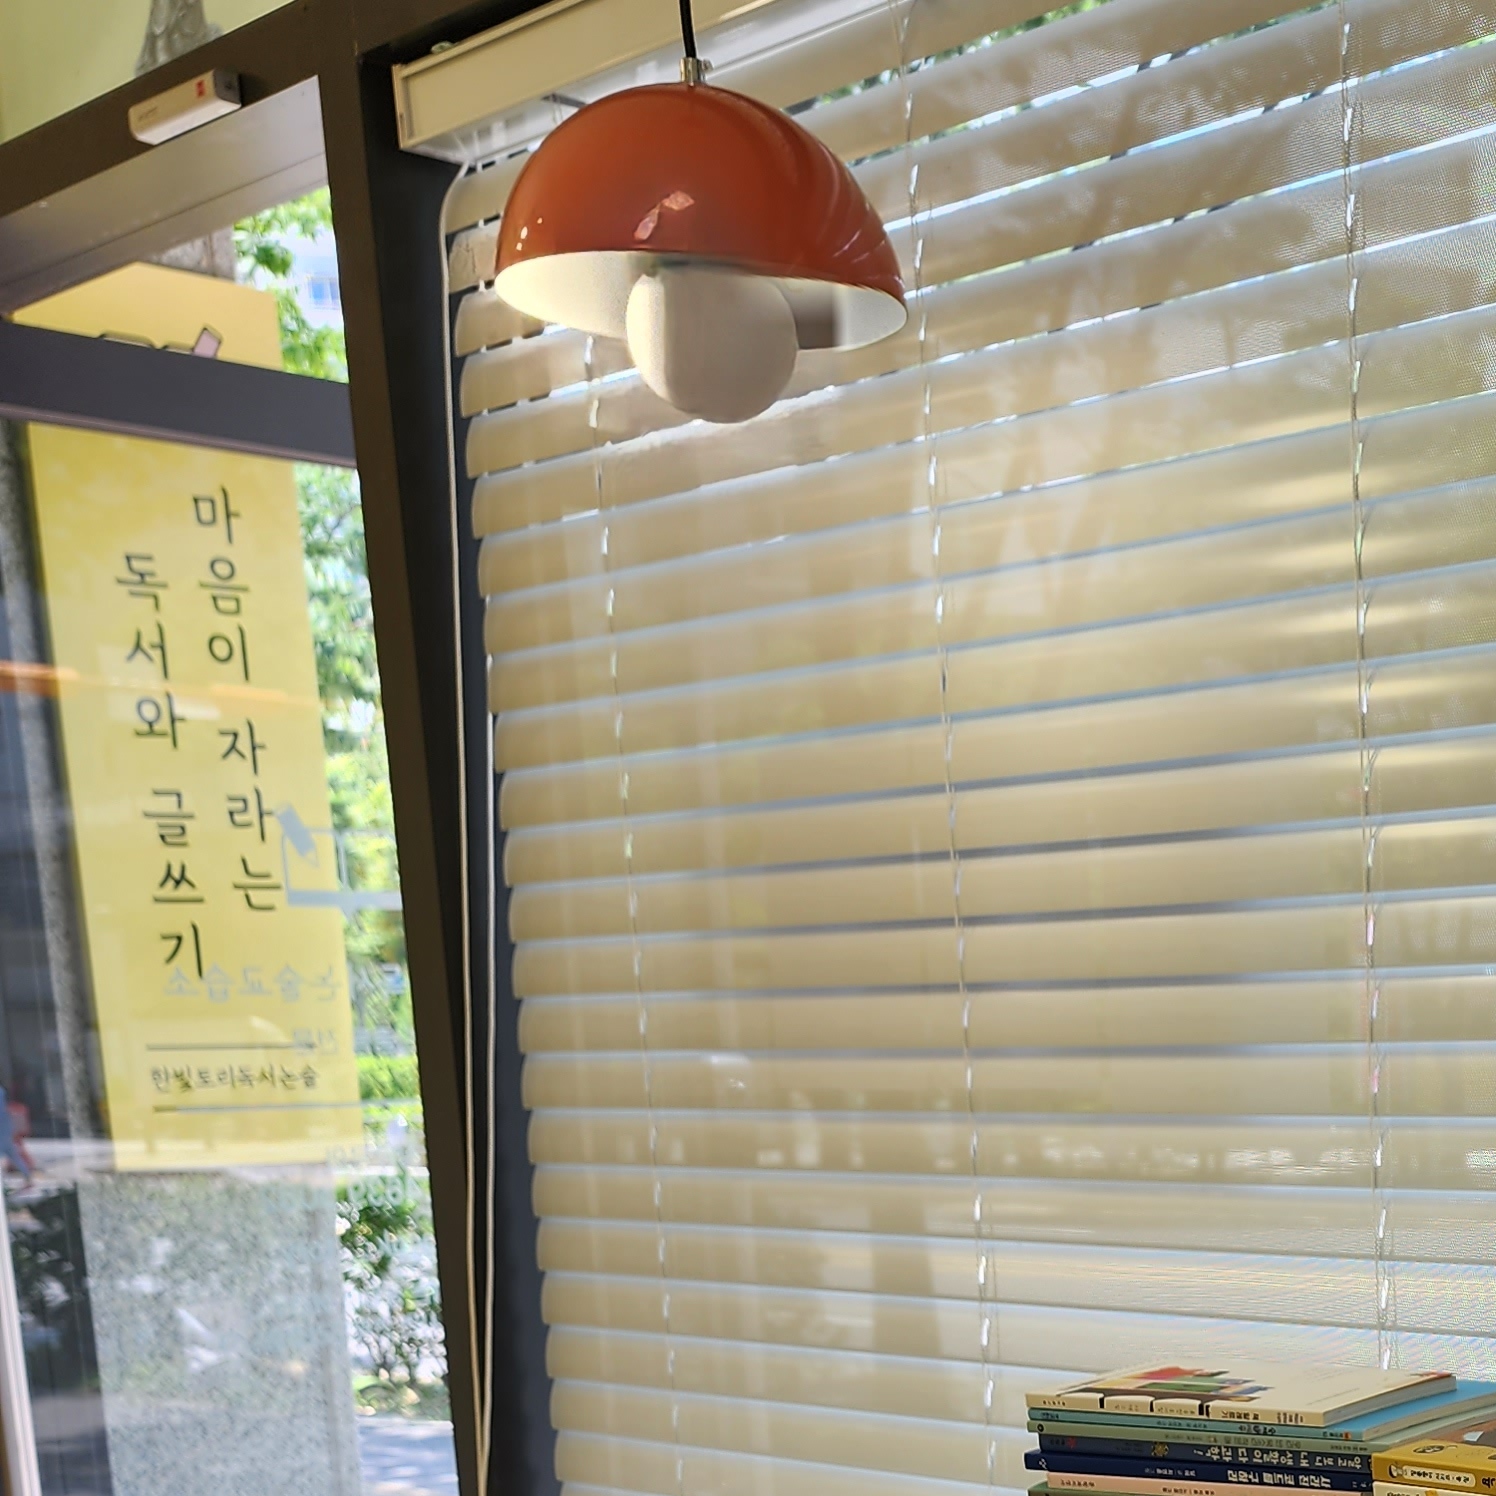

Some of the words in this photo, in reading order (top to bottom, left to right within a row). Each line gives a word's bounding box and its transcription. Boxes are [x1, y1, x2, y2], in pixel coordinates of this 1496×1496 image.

[192, 486, 250, 682] 마음이
[115, 553, 187, 750] 독서와
[220, 721, 282, 911] 자라는
[142, 788, 205, 978] 글쓰기
[151, 1063, 319, 1092] 한빛토리독서논술
[1195, 1444, 1230, 1462] 과학!
[1237, 1448, 1247, 1461] 다
[1254, 1450, 1292, 1466] 생활이
[1299, 1454, 1309, 1467] 내
[1315, 1456, 1333, 1468] 보니
[1336, 1457, 1361, 1471] 알고
[1227, 1469, 1258, 1483] 구하라
[1263, 1472, 1294, 1486] 코드를
[1299, 1474, 1332, 1488] 사라진
